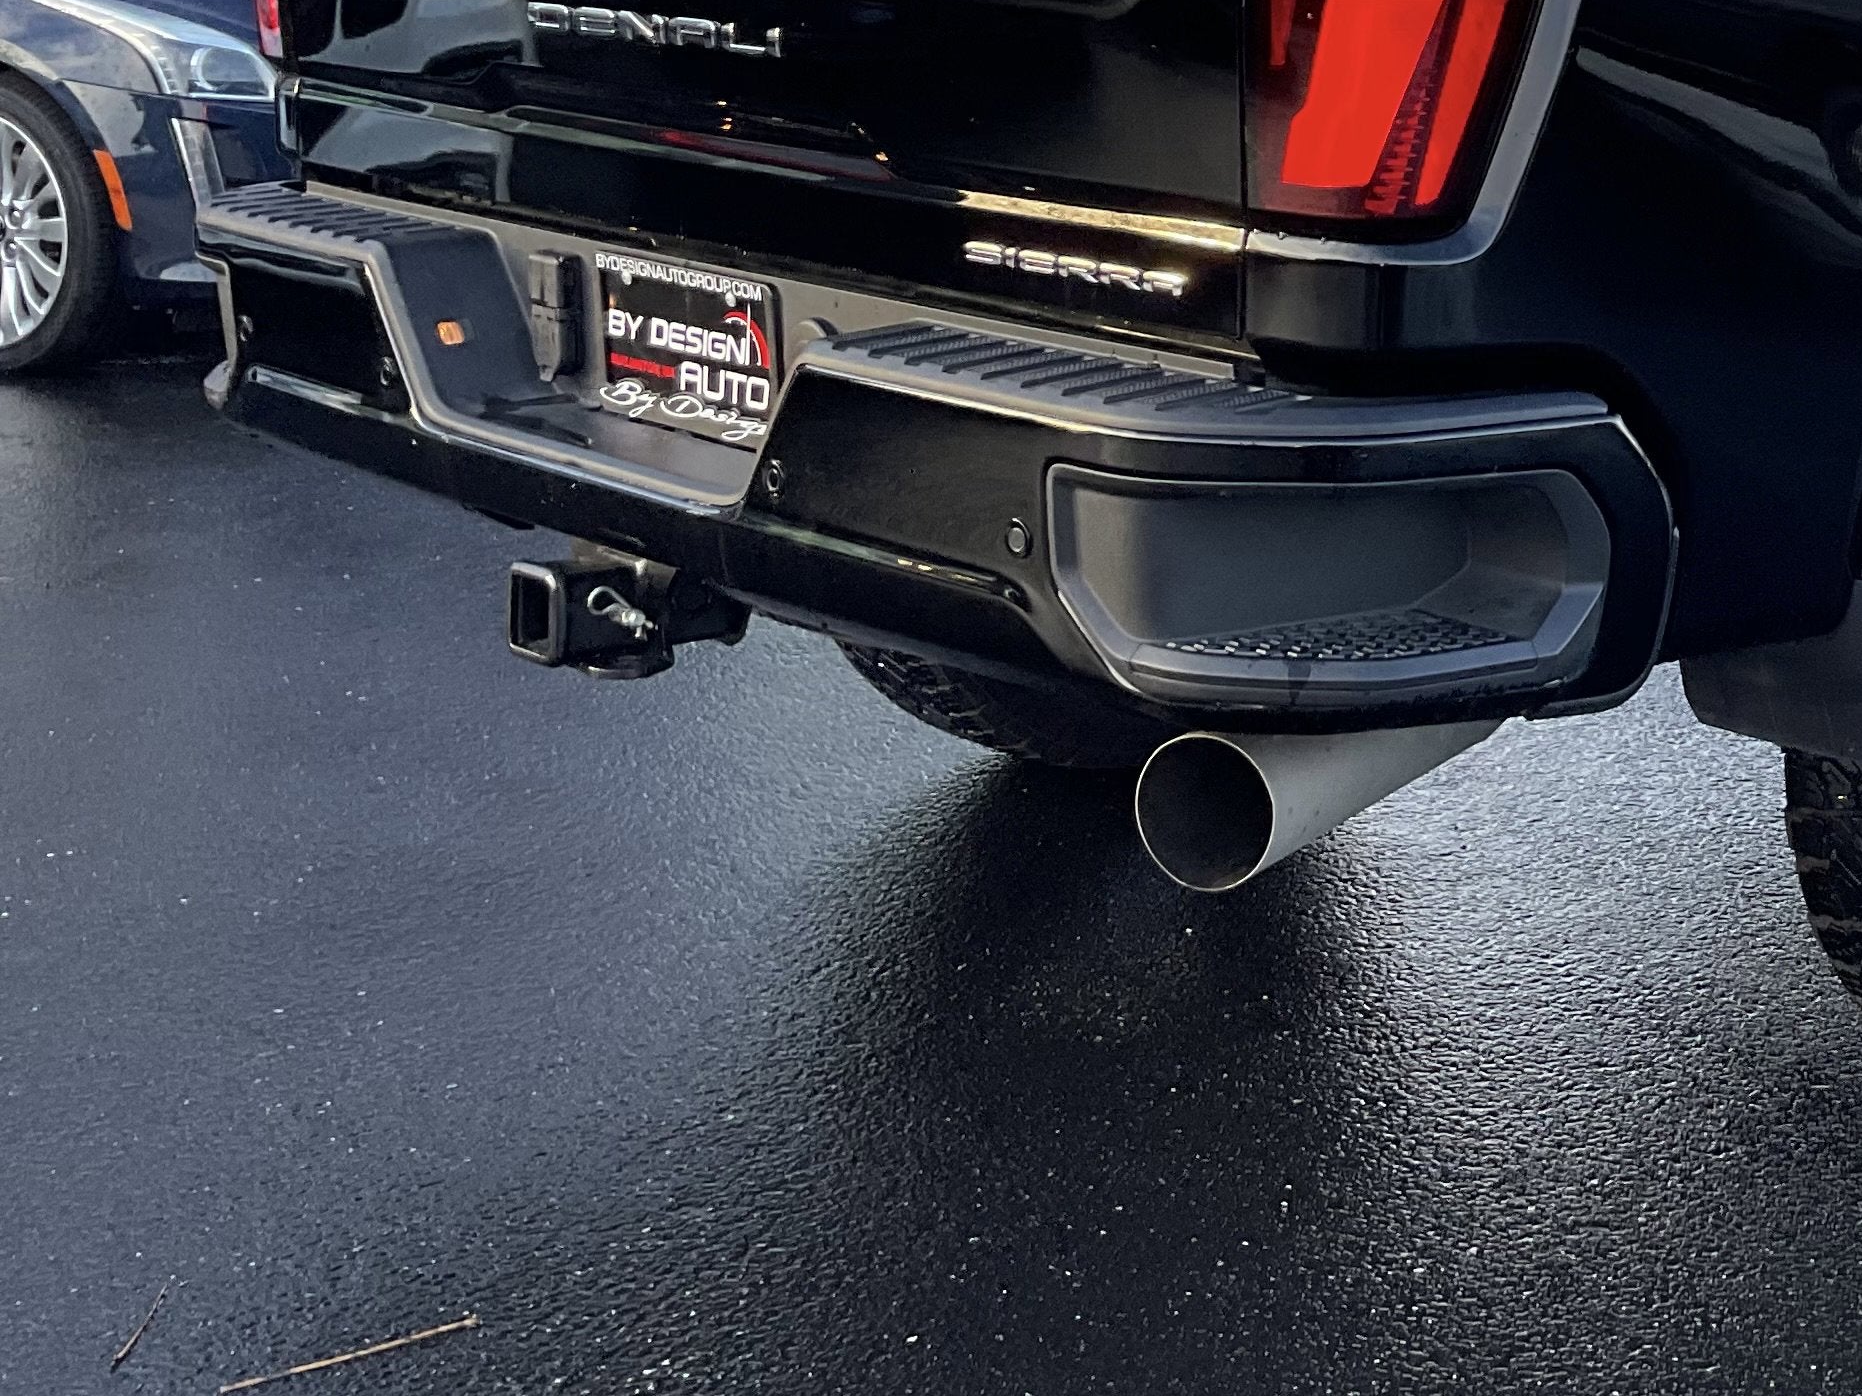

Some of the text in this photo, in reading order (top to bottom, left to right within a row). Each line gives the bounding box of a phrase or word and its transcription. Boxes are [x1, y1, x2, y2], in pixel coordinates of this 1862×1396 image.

[526, 1, 782, 58] DENALI
[963, 240, 1188, 297] SIERRA
[608, 307, 643, 340] BY
[650, 316, 746, 366] DESIGN
[600, 380, 659, 418] By
[680, 361, 770, 411] AUTO
